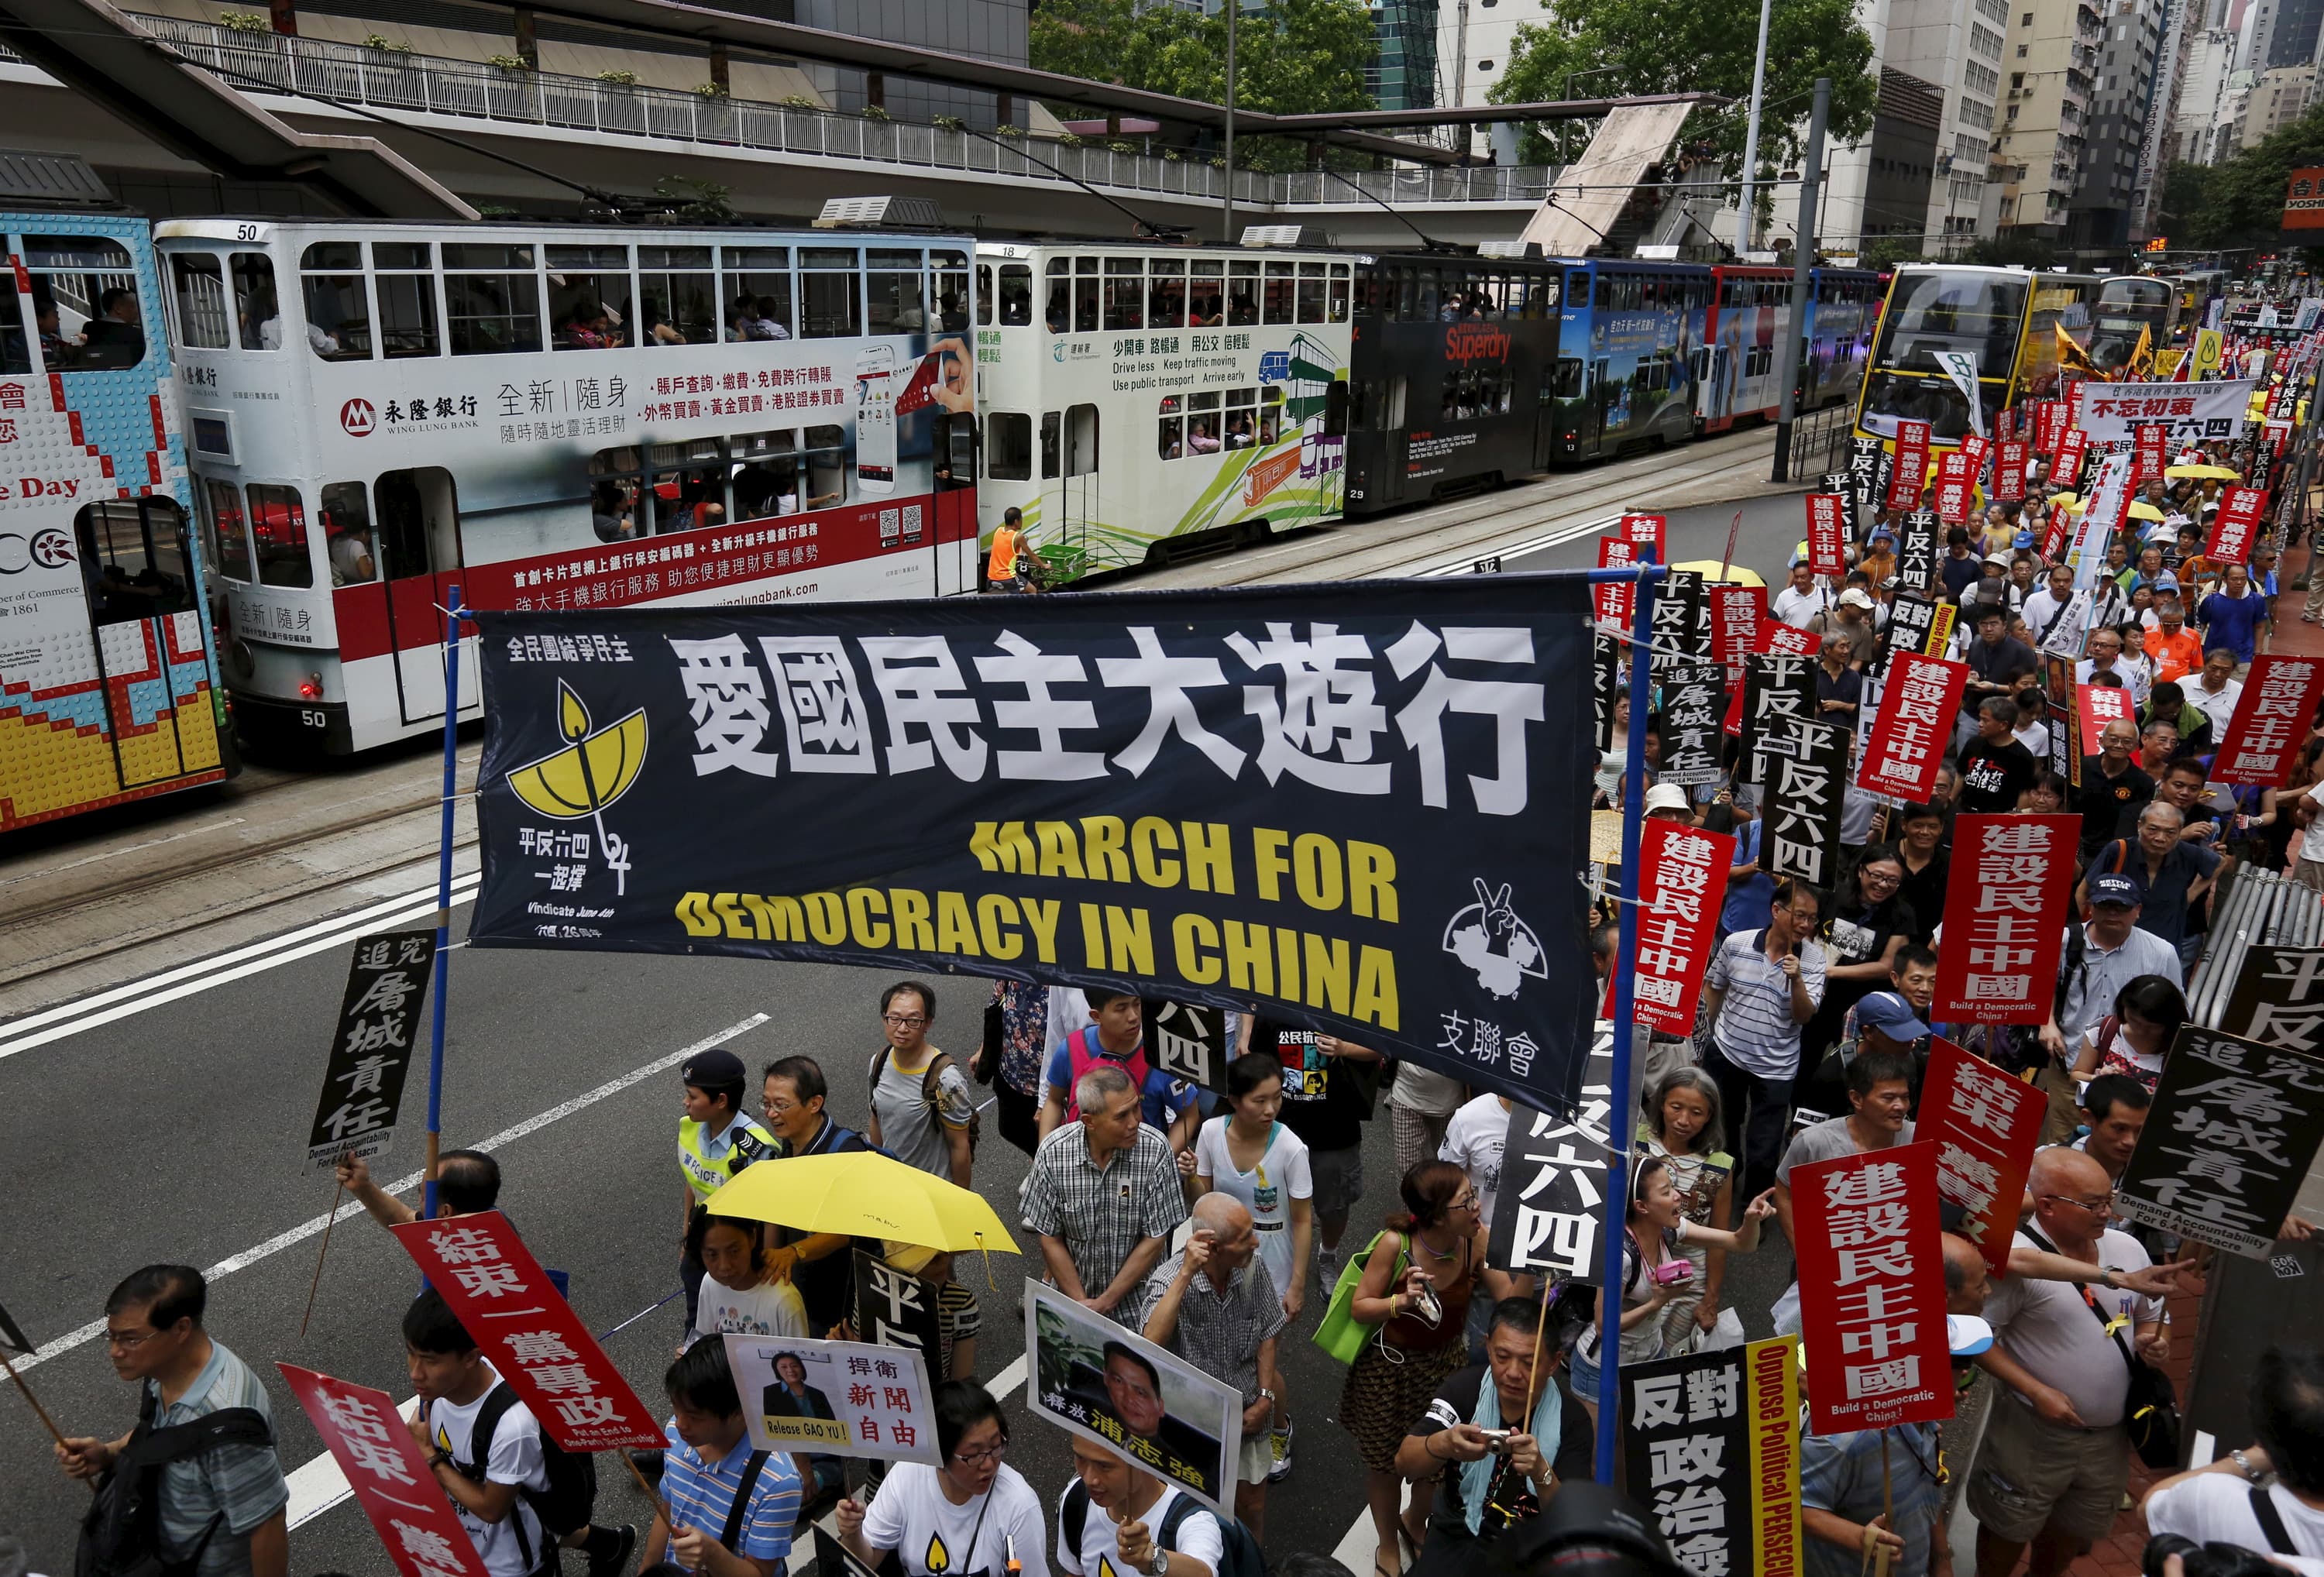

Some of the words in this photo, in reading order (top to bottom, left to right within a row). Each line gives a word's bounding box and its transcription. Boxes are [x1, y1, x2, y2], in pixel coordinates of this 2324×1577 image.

[237, 225, 257, 241] 50
[1002, 247, 1015, 256] 18
[1360, 256, 1373, 265] 29
[978, 331, 1001, 345] 暢通
[1113, 338, 1145, 358] 少開車
[1150, 337, 1179, 354] 路暢通
[1191, 335, 1219, 352] 用公交
[1225, 333, 1250, 350] 倍輕鬆
[1446, 327, 1511, 368] Superdry
[978, 349, 1001, 364] 輕鬆
[1113, 362, 1136, 373] Drive
[1138, 361, 1155, 372] less
[1164, 359, 1183, 372] Keep
[1184, 356, 1209, 369] traffic
[1211, 356, 1236, 368] moving
[657, 375, 713, 396] 賬戶查詢
[723, 372, 748, 391] 繳費
[758, 366, 831, 388] 免費跨行轉賬
[1113, 380, 1129, 391] Use
[1131, 377, 1157, 392] public
[1159, 374, 1195, 390] transport
[1203, 372, 1226, 383] Arrive
[1227, 370, 1245, 383] early
[2277, 377, 2299, 417] 平反六四
[384, 395, 478, 424] 永隆銀行
[645, 400, 701, 422] 外幣買賣
[711, 395, 763, 416] 黃金買賣
[772, 388, 844, 410] 港股證券買賣
[2092, 397, 2197, 418] 不忘初衷
[387, 425, 417, 435] WING
[419, 424, 447, 433] LUNG
[452, 421, 479, 430] BANK
[500, 415, 626, 444] 隨時隨地靈活理財
[1899, 424, 1923, 481] 結束一黨專政
[2001, 443, 2023, 494] 結束一黨專政
[2057, 430, 2083, 479] 結束一黨專政
[2252, 441, 2272, 490] 平反六四
[20, 477, 80, 500] Day
[1350, 490, 1363, 499] 29
[1940, 453, 1968, 516] 結束一黨專政
[1813, 496, 1836, 566] 建設民主中國
[2216, 490, 2257, 558] 結束一黨專政
[514, 543, 694, 589] 首創卡片型網上銀行保安編碼器
[712, 523, 819, 552] 全新升級手機銀行服務
[1903, 512, 1934, 590] 平反六四
[15, 590, 26, 601] of
[28, 586, 80, 600] Commerce
[516, 573, 660, 610] 強大手機銀行服務
[668, 545, 819, 588] 助您便捷理財更顯優勢
[12, 603, 39, 616] 1861
[1892, 600, 1933, 628] 反對
[1934, 606, 1952, 638] Oppose
[507, 635, 634, 663] 全民團結爭民主
[1723, 591, 1756, 681] 建設民主中國
[1668, 667, 1720, 684] 追究
[2068, 661, 2077, 702] FREE
[301, 710, 325, 727] 50
[668, 620, 1545, 816] 愛國民主大遊行
[1666, 685, 1717, 770] 屠城責任
[1879, 660, 1952, 783] 建設民主中國
[2233, 661, 2316, 771] 建設民主中國
[1682, 769, 1718, 778] Accountability
[2071, 733, 2080, 784] Xiaobo
[1869, 775, 1885, 784] Build
[1890, 779, 1923, 792] Democratic
[1884, 785, 1900, 794] China
[1772, 718, 1834, 885] 平反六四
[519, 827, 590, 859] 平反六四
[535, 864, 586, 892] 一起撐
[969, 816, 1236, 895] MARCH
[1253, 827, 1398, 923] FOR
[528, 902, 576, 917] Vindicate
[576, 906, 598, 917] June
[597, 908, 615, 918] 4th
[1634, 830, 1716, 1008] 建設民主中國
[1965, 823, 2054, 1000] 建設民主中國
[357, 936, 428, 970] 追究
[675, 888, 1061, 964] DEMOCRACY
[1080, 902, 1156, 976] IN
[1171, 913, 1400, 1032] CHINA
[1644, 1003, 1683, 1020] Democratic
[1950, 1002, 1973, 1010] Build
[1984, 1002, 2036, 1011] Democratic
[1976, 1012, 2002, 1020] China
[2244, 951, 2324, 1052] 平反
[1636, 1012, 1656, 1024] China
[1278, 1031, 1319, 1044] 公民抗
[1436, 1008, 1539, 1077] 支聯會
[322, 971, 417, 1141] 屠城責任
[2186, 1036, 2324, 1092] 追究
[308, 1143, 341, 1160] Demand
[341, 1131, 391, 1151] Accountability
[2140, 1077, 2308, 1229] 屠城責任
[316, 1159, 329, 1169] For
[692, 1160, 717, 1184] POLICE
[2120, 1195, 2172, 1218] Demand
[2174, 1216, 2267, 1249] Accountability
[2135, 1211, 2157, 1225] For
[2159, 1220, 2178, 1231] 6.4
[2181, 1228, 2242, 1252] Massacre
[1821, 1162, 1920, 1400] 建設民主中國
[428, 1228, 627, 1427] 結束一黨專政
[847, 1356, 898, 1379] 捍衛
[1755, 1345, 1789, 1421] Oppose
[847, 1383, 912, 1413] 新聞
[1631, 1363, 1740, 1431] 反對
[1831, 1400, 1860, 1416] Build
[1863, 1401, 1870, 1411] a
[1873, 1390, 1935, 1409] Democratic
[572, 1428, 586, 1437] Put
[601, 1426, 620, 1436] End
[768, 1420, 800, 1434] Release
[803, 1422, 823, 1437] GAO
[827, 1425, 839, 1439] YU
[859, 1416, 916, 1447] 自由
[1865, 1408, 1896, 1424] China
[1047, 1392, 1088, 1424] 釋放
[1091, 1408, 1205, 1491] 浦志強
[1759, 1421, 1791, 1503] Political
[315, 1386, 468, 1577] 結束一黨
